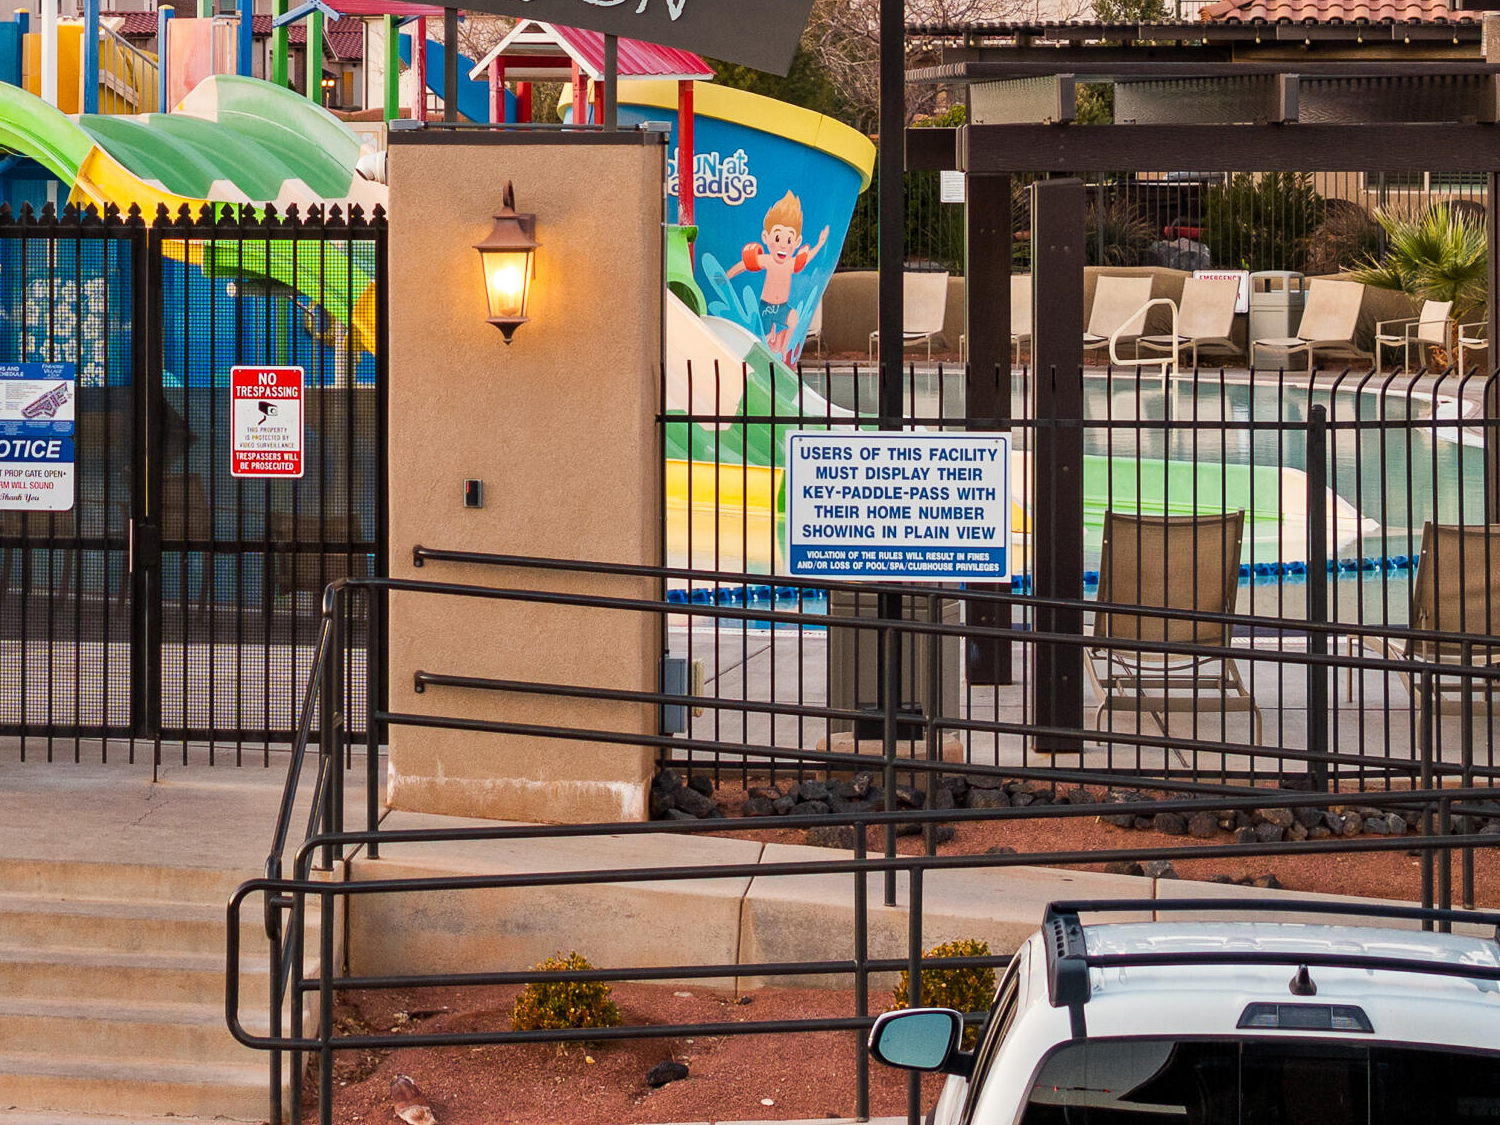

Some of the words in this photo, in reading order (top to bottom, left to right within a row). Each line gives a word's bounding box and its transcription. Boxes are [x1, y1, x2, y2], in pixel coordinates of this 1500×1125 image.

[726, 152, 746, 176] at
[258, 372, 277, 385] NO
[236, 386, 298, 397] TRESPASSING
[236, 452, 281, 461] TRESPASSERS
[283, 453, 298, 461] WILL
[800, 447, 852, 460] USERS
[860, 447, 881, 461] OF
[887, 447, 922, 461] THIS
[929, 448, 998, 462] FACILITY
[240, 462, 249, 470] BE
[251, 462, 294, 470] PROSECUTED
[4, 469, 23, 478] PROP
[25, 469, 42, 478] GATE
[816, 466, 858, 480] MUST
[865, 467, 930, 480] DISPLAY
[937, 468, 983, 481] THEIR
[11, 481, 28, 489] WILL
[29, 481, 54, 489] SOUND
[0, 492, 22, 501] Thank
[24, 493, 40, 502] You
[803, 486, 950, 500] KEY-PADDLE-PASS
[957, 487, 996, 501] WITH
[814, 505, 859, 519] THEIR
[867, 506, 911, 519] HOME
[918, 506, 984, 520] NUMBER
[802, 524, 875, 539] SHOWING
[882, 525, 897, 538] IN
[904, 526, 949, 539] PLAIN
[956, 526, 996, 540] VIEW
[806, 550, 846, 560] VIOLATION
[848, 551, 859, 560] OF
[861, 551, 876, 560] THE
[878, 551, 903, 560] RULES
[905, 551, 924, 561] WILL
[925, 552, 955, 561] RESULT
[957, 552, 965, 561] IN
[967, 552, 990, 561] FINES
[797, 560, 828, 570] AND/OR
[830, 561, 851, 570] LOSS
[853, 561, 863, 570] OF
[865, 561, 954, 571] POOL/SPA/CLUBHOUSE
[956, 562, 999, 572] PRIVILEGES
